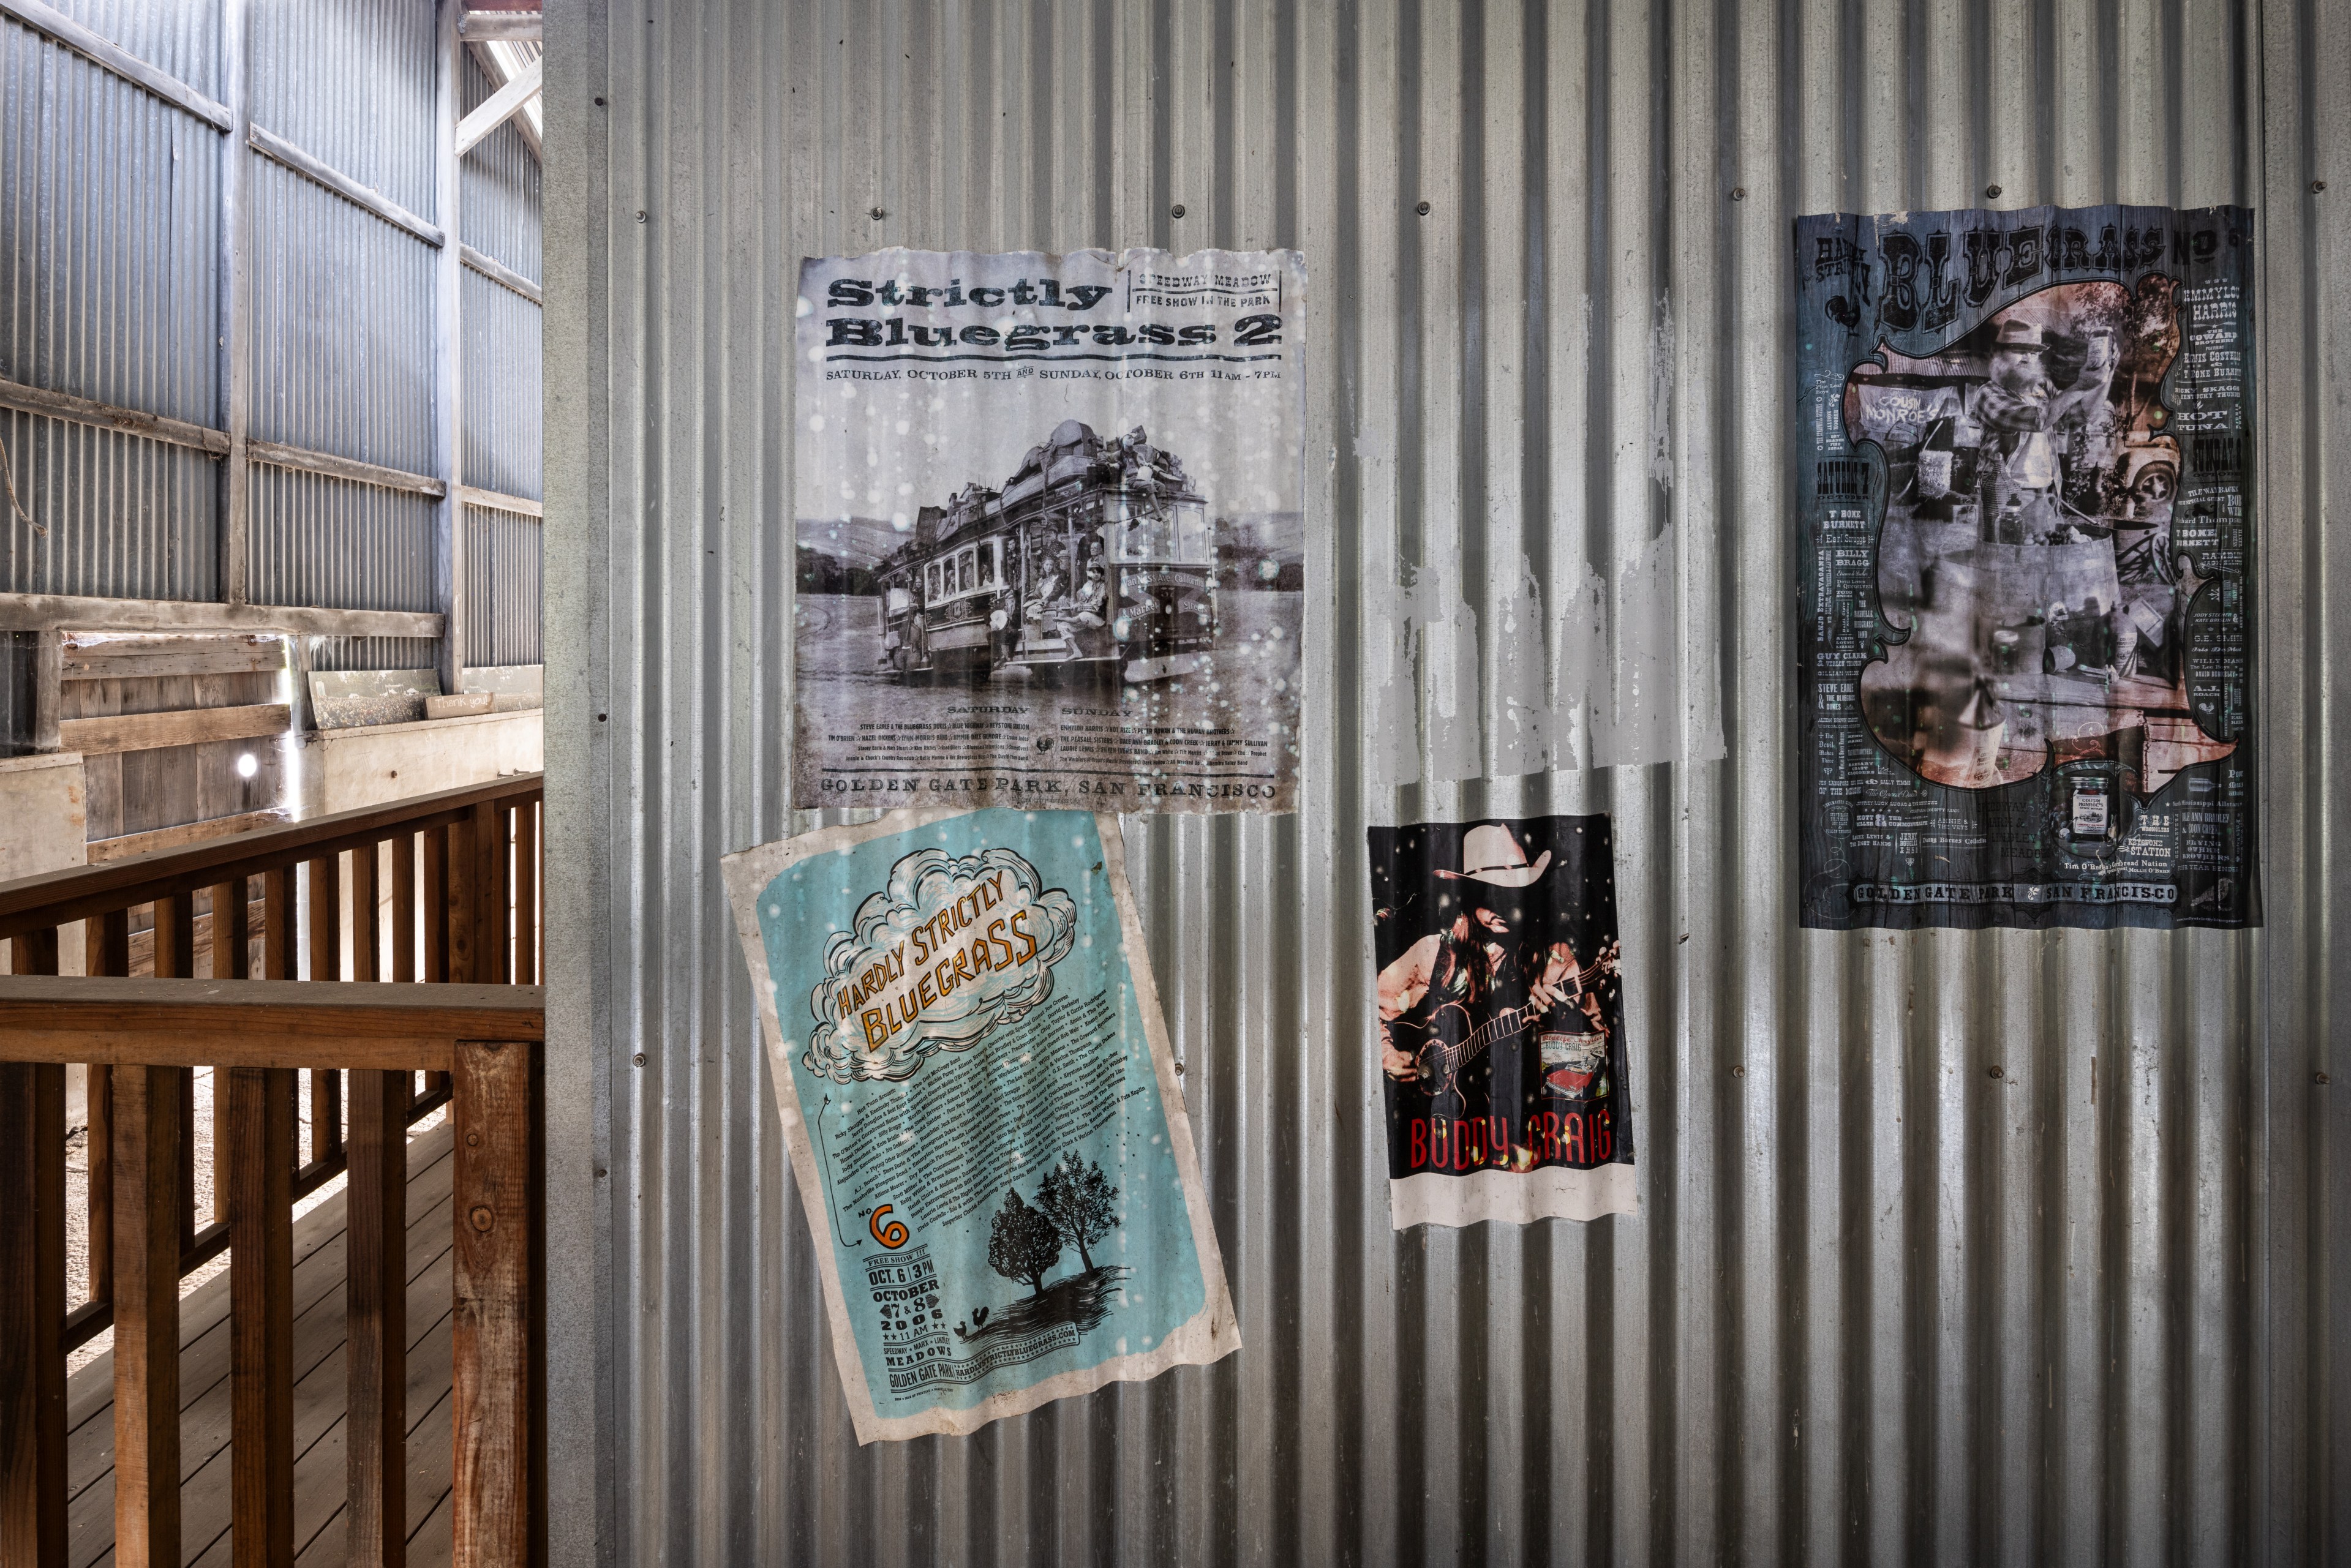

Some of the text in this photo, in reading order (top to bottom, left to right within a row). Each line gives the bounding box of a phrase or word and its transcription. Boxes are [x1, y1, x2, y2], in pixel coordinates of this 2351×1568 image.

[1140, 274, 1271, 287] SPEEDWAY MEADOW
[1878, 223, 2166, 334] BLUEGRASS
[827, 278, 1113, 311] Strictly
[1137, 294, 1270, 307] FREE SHOW IN THE PARK
[2184, 286, 2240, 321] EMMYLOU HARRIS
[826, 313, 1283, 352] Bluegrass 2
[2189, 332, 2237, 342] COWARD
[826, 369, 901, 380] SATURDAY,
[907, 369, 978, 380] OCTOBER
[983, 370, 1012, 380] 5TH
[1016, 367, 1034, 378] AND
[1039, 369, 1102, 380] SUNDAY,
[1104, 369, 1174, 380] OCTOBER
[1179, 370, 1205, 380] 6TH
[1210, 370, 1242, 381] 11AM
[1254, 370, 1281, 380] 7PM
[1879, 396, 1921, 410] COUSIN
[1866, 405, 1938, 424] MONROE'S
[2177, 410, 2227, 421] HOT
[1841, 509, 1861, 519] BONE
[1823, 520, 1866, 529] BURNETT
[1826, 534, 1866, 545] Earl Scruggs
[1175, 574, 1205, 587] California
[1129, 601, 1157, 618] Market
[1818, 683, 1854, 693] STEVE EARLE
[435, 694, 488, 708] Thank you!
[1061, 708, 1133, 717] SUNDAY
[821, 778, 1276, 800] GOLDEN GATE PARK, SAN FRANCISCO
[2131, 846, 2171, 857] STATION
[1857, 885, 2174, 901] GOLDEN GATE PARK SAN FRANCISCO
[838, 871, 1002, 1020] HARDLY STRICTLY
[861, 909, 1038, 1053] BLUEGRASS
[1542, 1034, 1571, 1043] Midlife
[1546, 1041, 1582, 1052] BUDDY CRAIG
[835, 1129, 847, 1140] Ricky
[848, 1117, 865, 1133] Skaggs
[870, 1101, 890, 1117] Kentucky
[890, 1092, 908, 1105] Thunder
[912, 1081, 922, 1090] The
[931, 1064, 950, 1078] McCoury
[950, 1056, 961, 1066] Band
[857, 1087, 897, 1115] Hot Tuna Acoustic
[1410, 1108, 1612, 1171] BUDDY CRAIG
[942, 1214, 963, 1227] Songwriter
[963, 1204, 977, 1216] Circle
[977, 1187, 999, 1206] featuring
[1000, 1179, 1013, 1188] Steve
[1012, 1172, 1026, 1182] Earle,
[1026, 1164, 1037, 1176] Billy
[1037, 1153, 1052, 1168] Bragg,
[1051, 1145, 1062, 1155] Guy
[1062, 1138, 1074, 1147] Clark
[1078, 1129, 1093, 1141] Verlon
[1093, 1110, 1117, 1131] Thompson
[858, 1203, 910, 1250] NO. 6
[868, 1248, 926, 1267] FREE SHOW !!!
[868, 1259, 935, 1286] OCT. 6 3 PM
[873, 1278, 940, 1303] OCTOBER
[891, 1297, 926, 1318] 7 & 8
[881, 1308, 943, 1331] 2006
[900, 1324, 928, 1341] 11 AM
[914, 1340, 929, 1351] MARX
[934, 1336, 950, 1345] LINDLEY
[955, 1329, 1075, 1377] HARDLYSTRICTLYBLUEGRASS.COM
[886, 1346, 952, 1367] MEADOWS
[889, 1362, 954, 1389] GOLDEN GATE PARK
